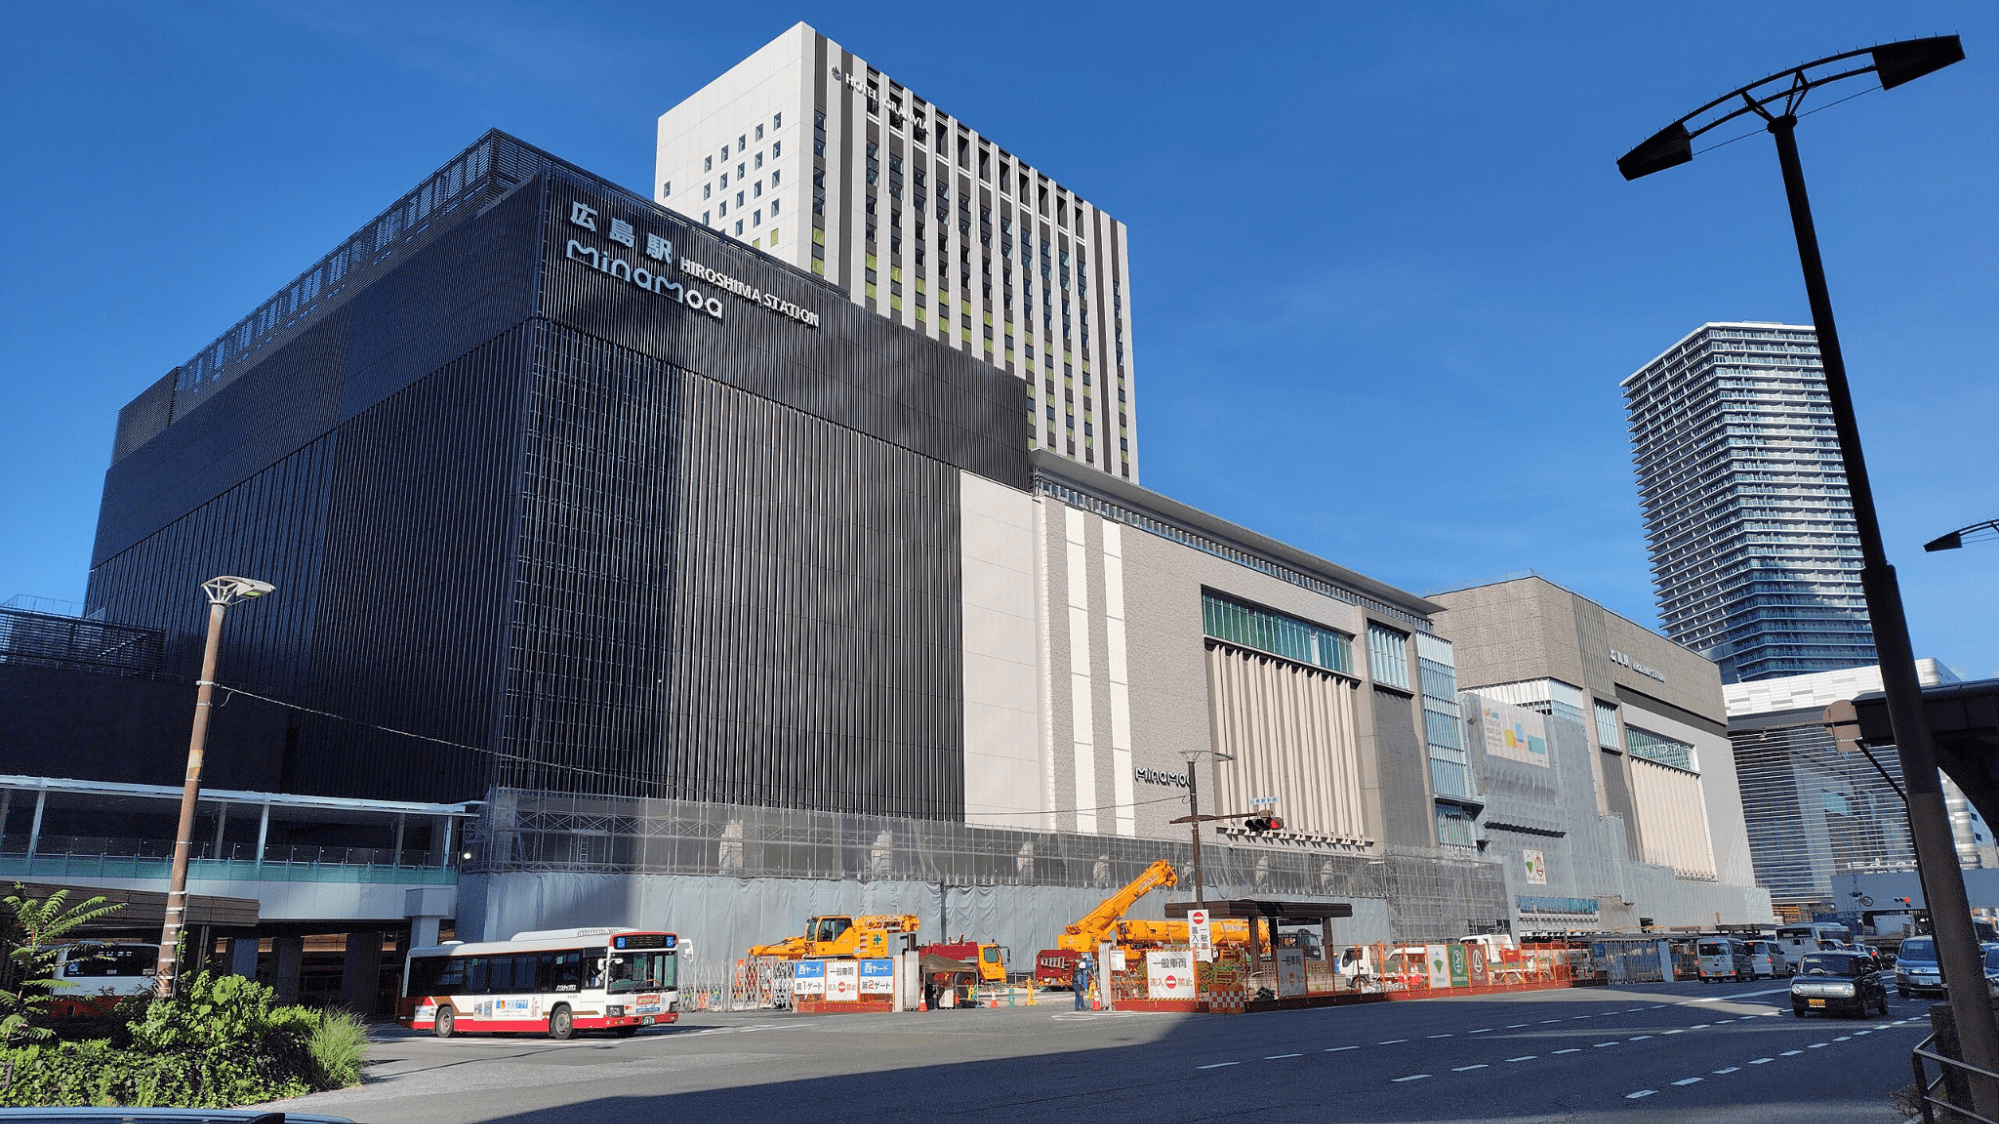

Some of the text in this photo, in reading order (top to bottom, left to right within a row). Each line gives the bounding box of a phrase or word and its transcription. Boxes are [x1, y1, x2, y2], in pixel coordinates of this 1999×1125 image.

[845, 72, 930, 135] HOTEL GRANVIA
[570, 201, 672, 264] 広島駅
[680, 256, 819, 327] HIROSHIMA STATION
[798, 963, 821, 975] 西ヤード
[864, 962, 889, 974] 西ヤード
[1153, 957, 1187, 969] 一般車両
[796, 980, 823, 991] 第1ゲート
[861, 979, 891, 991] 第2ゲート
[1150, 977, 1193, 987] 進入 禁止
